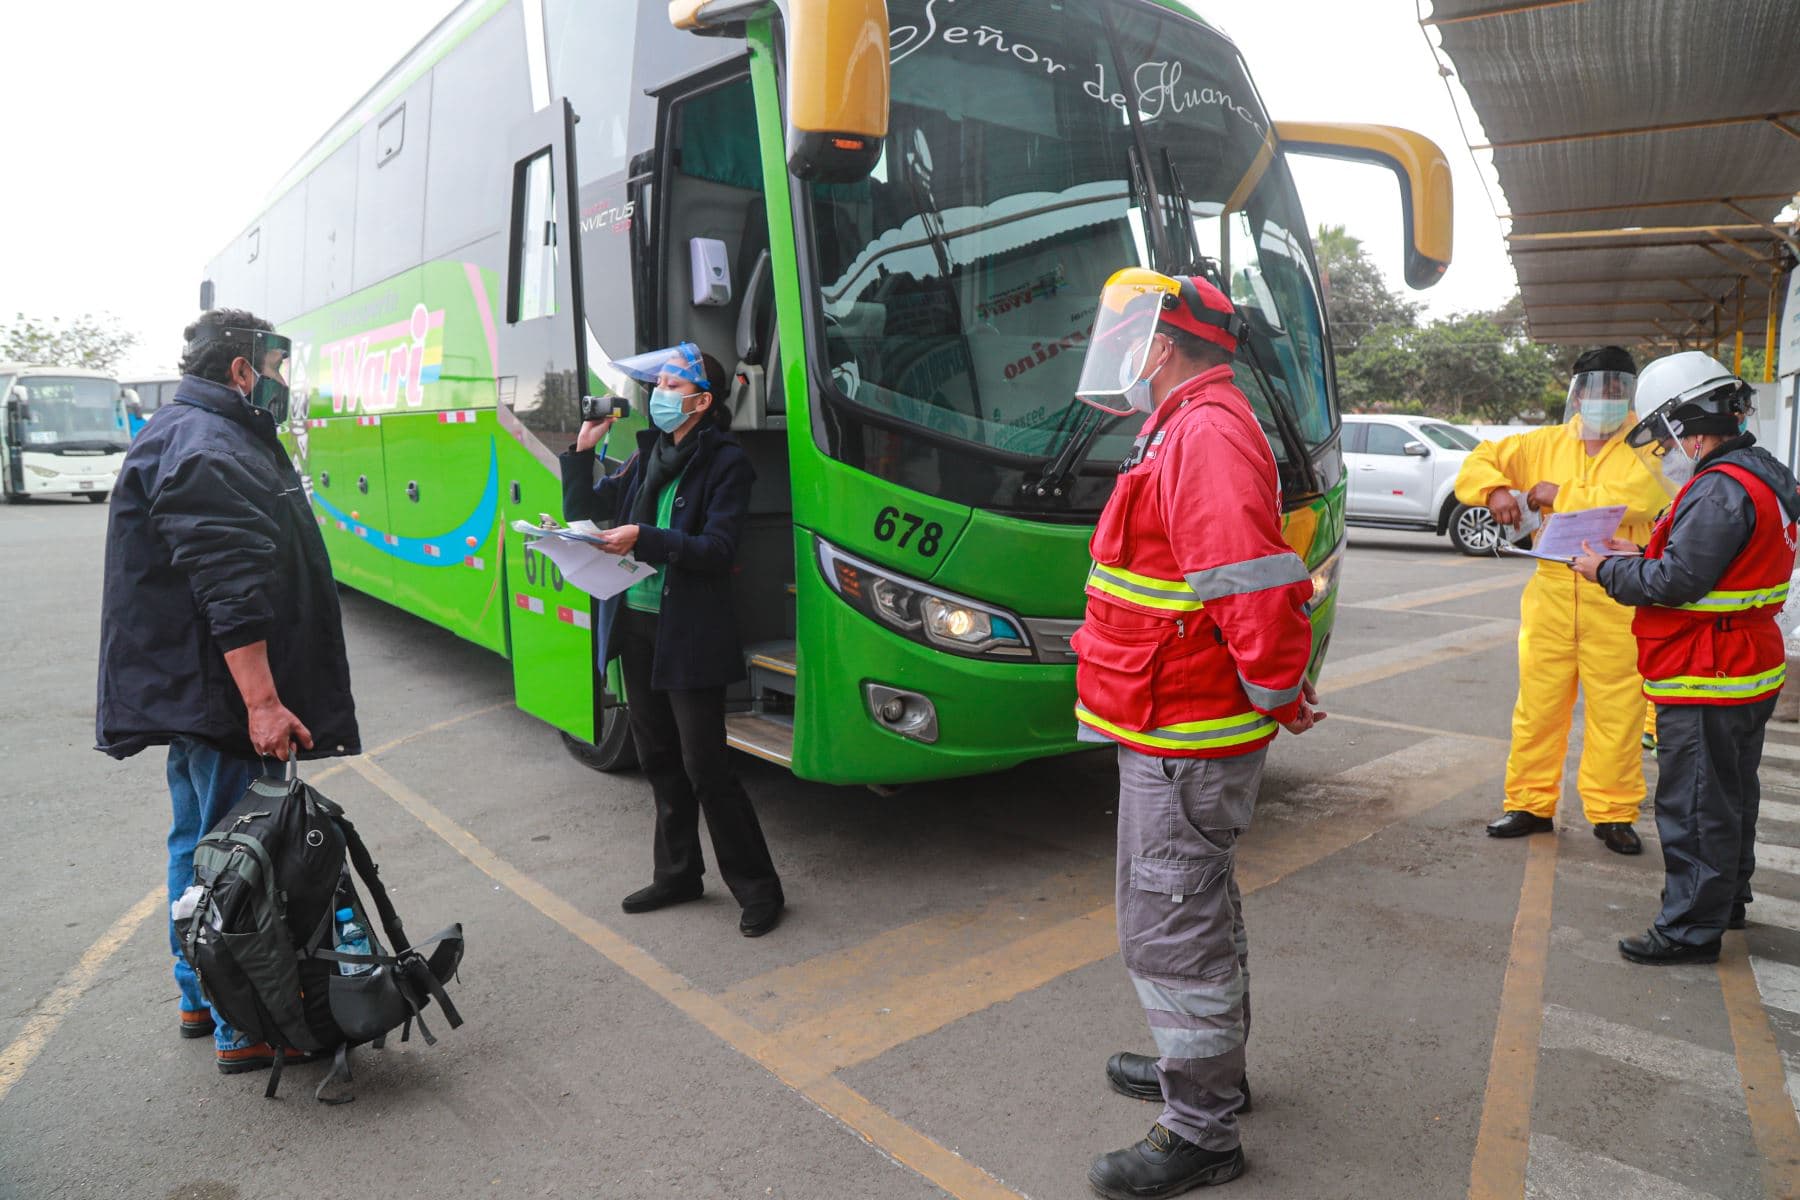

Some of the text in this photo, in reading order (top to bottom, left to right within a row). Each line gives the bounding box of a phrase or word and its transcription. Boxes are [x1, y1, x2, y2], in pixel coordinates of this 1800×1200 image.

[890, 0, 1066, 74] Señor
[1083, 63, 1127, 108] de
[580, 200, 636, 233] NVICTUS
[330, 303, 429, 413] Wari
[874, 505, 944, 558] 678
